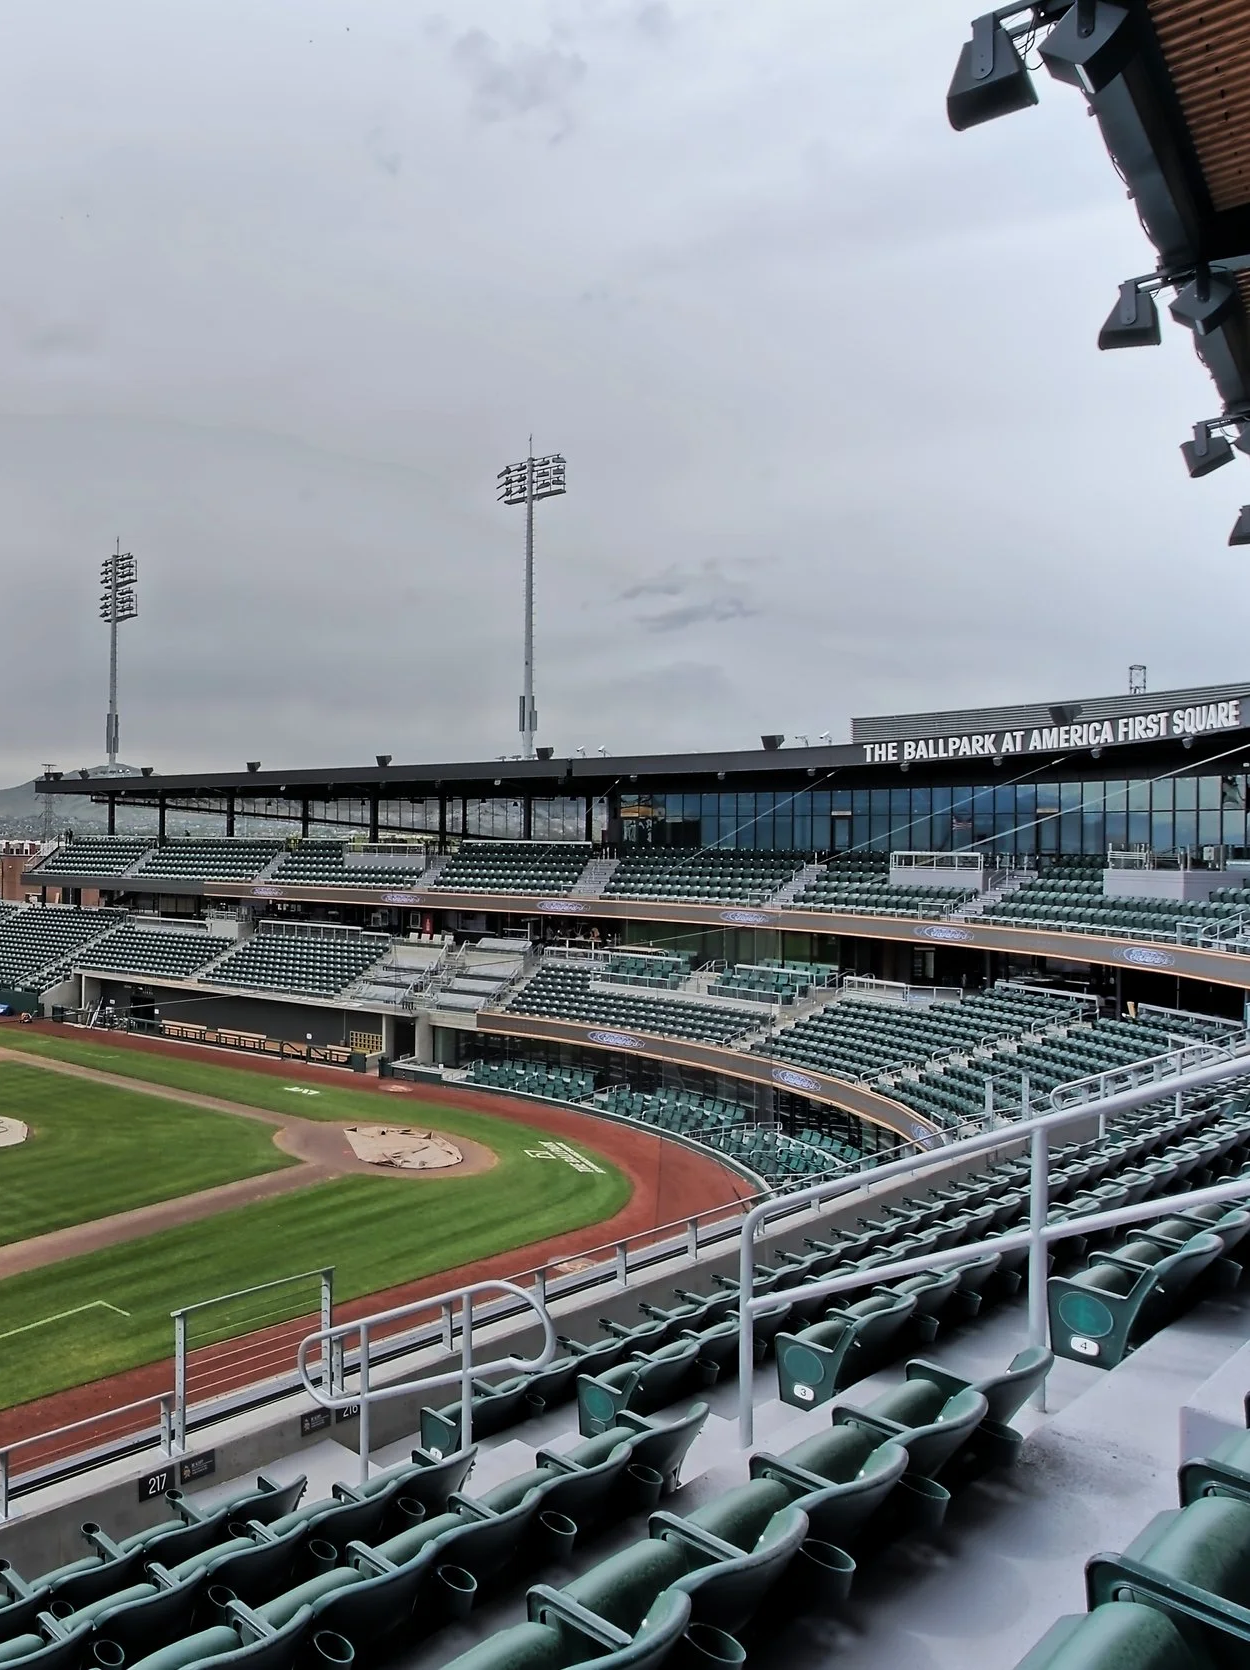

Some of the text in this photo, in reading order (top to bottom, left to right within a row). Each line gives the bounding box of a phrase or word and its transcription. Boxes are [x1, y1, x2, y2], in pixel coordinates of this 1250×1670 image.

[863, 700, 1241, 763] THE BALLPARK AT AMERICA FIRST SQUARE
[1080, 1342, 1087, 1350] 4
[800, 1388, 807, 1397] 3
[148, 1472, 168, 1495] 217
